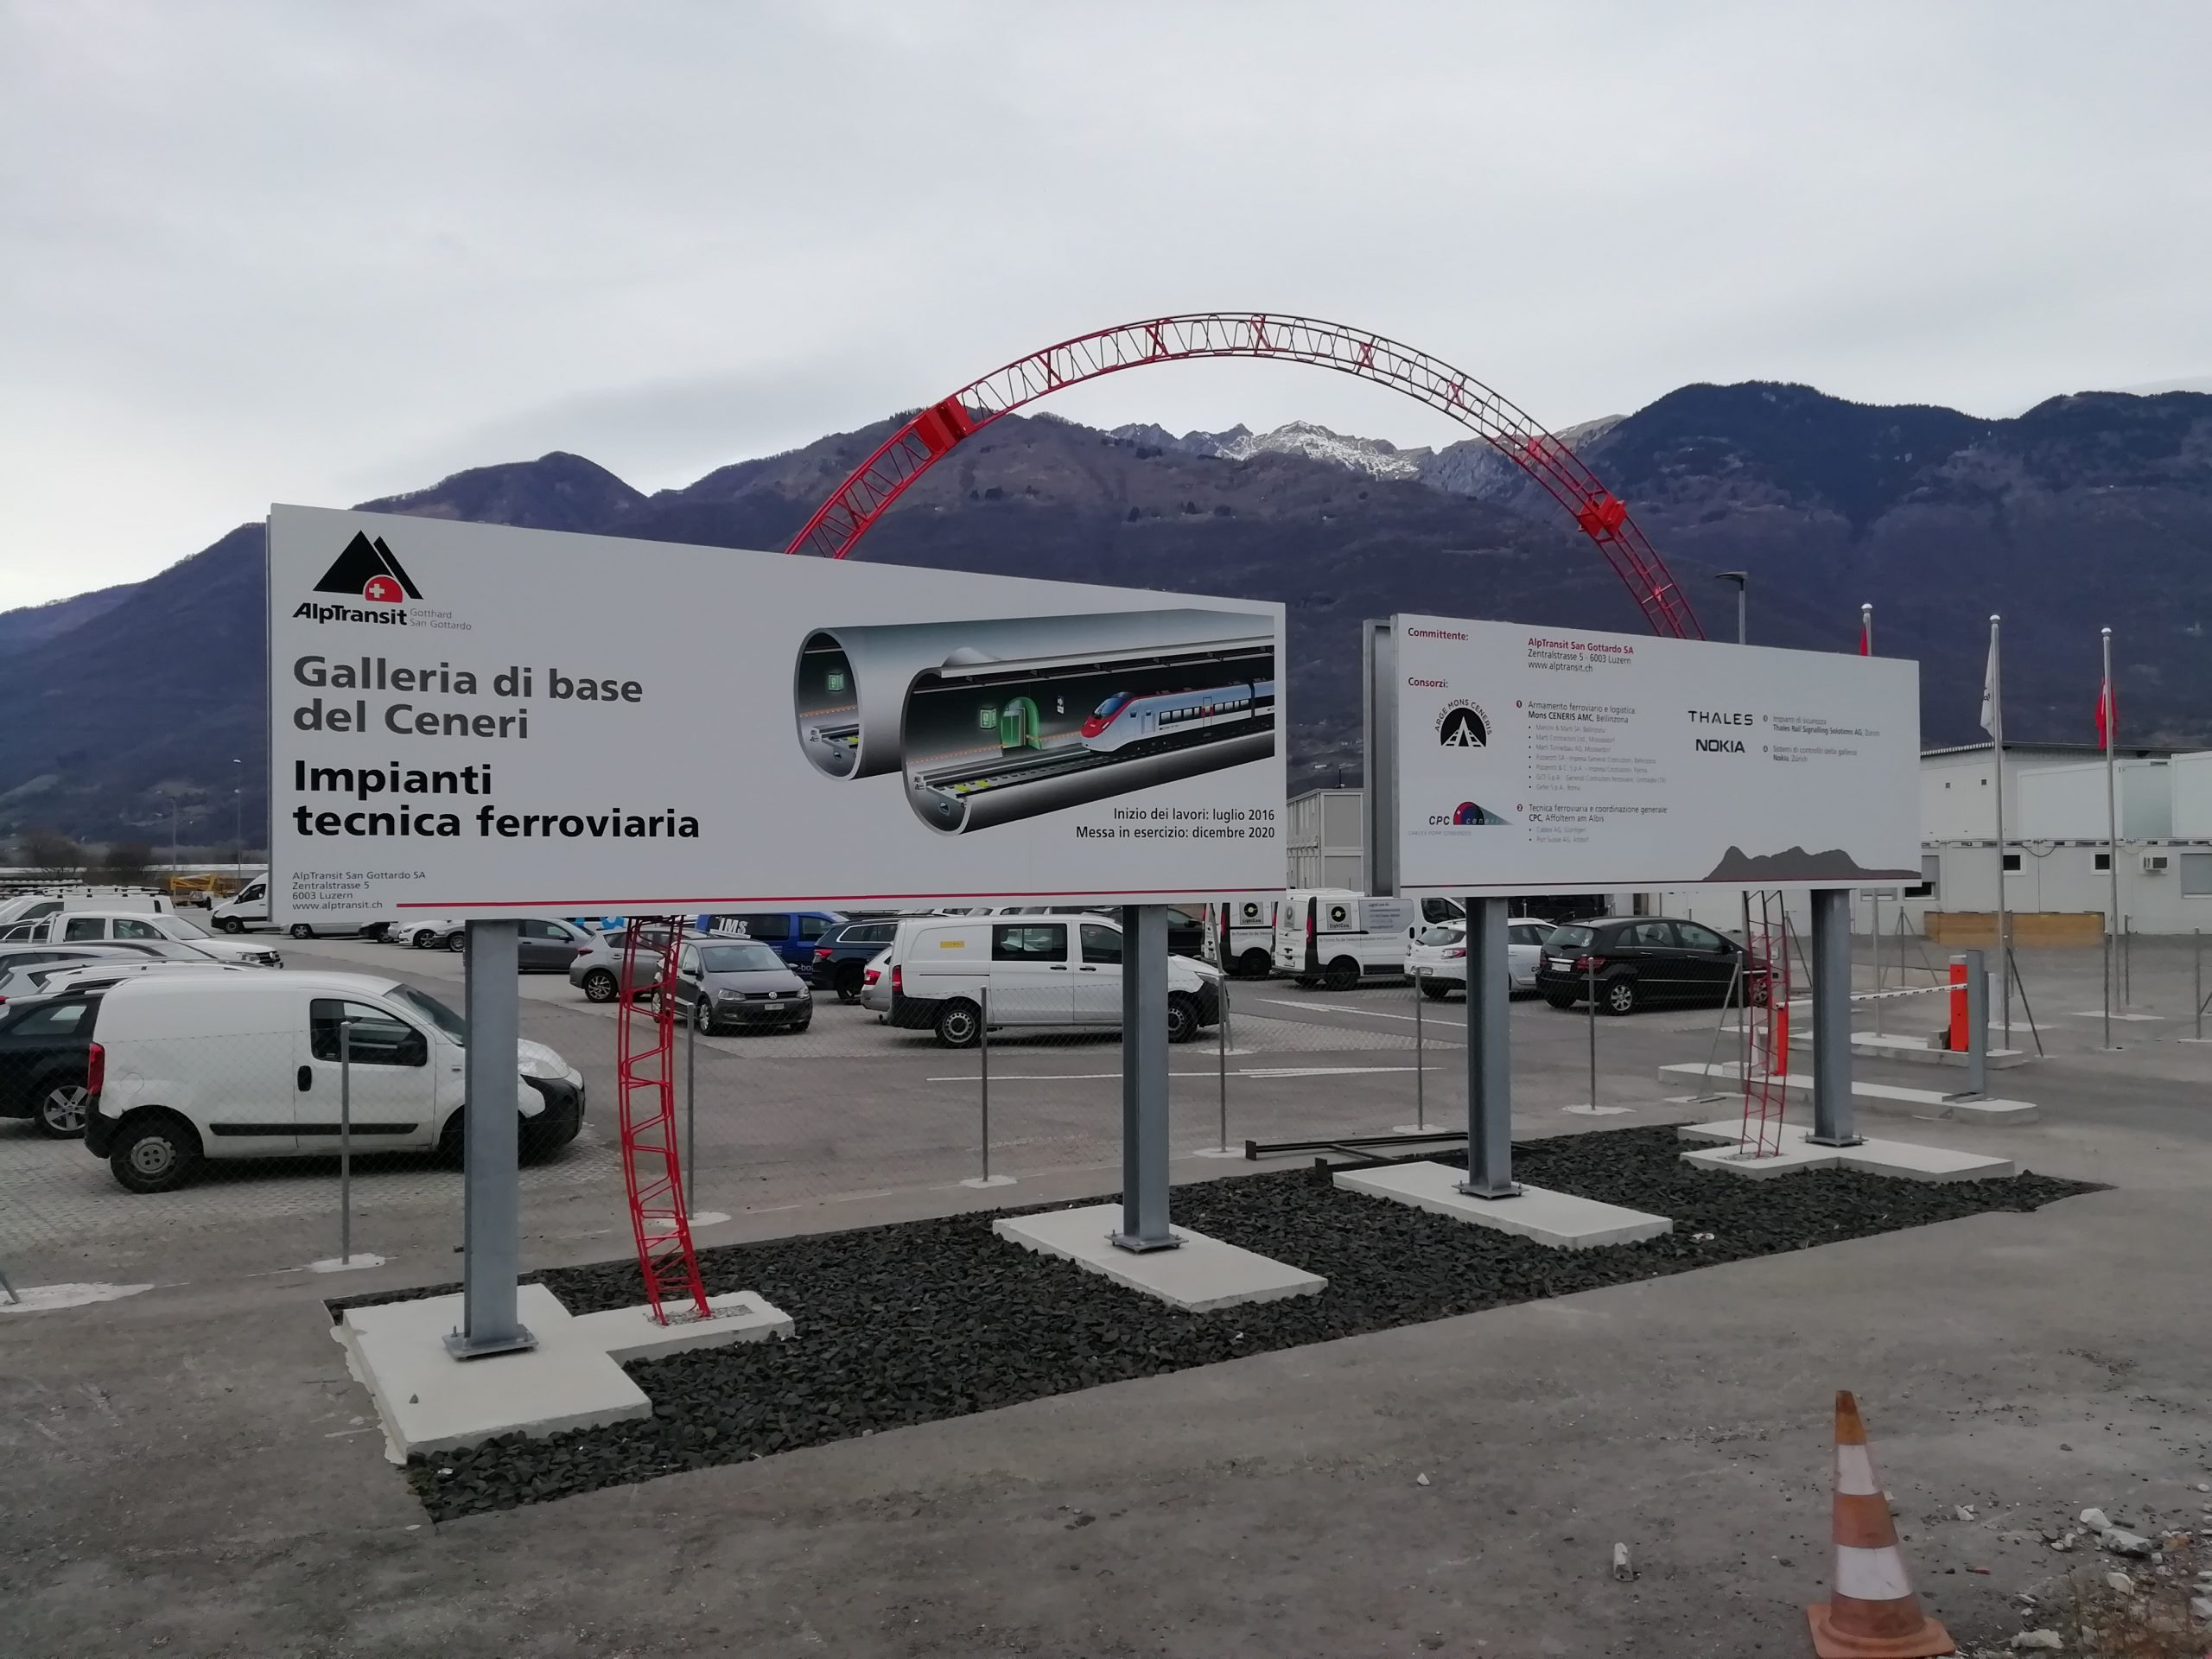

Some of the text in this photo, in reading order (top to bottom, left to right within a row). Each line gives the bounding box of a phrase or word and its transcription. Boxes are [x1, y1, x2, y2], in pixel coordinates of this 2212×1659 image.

[292, 602, 407, 626] AlpTransit
[410, 608, 452, 619] Gotthard
[410, 619, 472, 630] San Gottardo
[1408, 628, 1468, 640] Committente:
[1529, 638, 1568, 649] AlpTransit
[1571, 641, 1585, 651] San
[1588, 643, 1621, 653] Gottardo
[1528, 649, 1577, 660] Zentralstrasse
[1590, 654, 1606, 663] 6003
[1608, 656, 1631, 664] Luzern
[1529, 662, 1592, 672] www.alptransit.ch
[294, 655, 643, 702] Galleria di base
[1408, 677, 1448, 688] Consorzi:
[1529, 701, 1567, 710] Armamento
[294, 698, 527, 739] del Ceneri
[1434, 708, 1447, 732] ARGE
[1448, 699, 1469, 709] MONS
[1548, 712, 1575, 721] CENERIS
[1688, 710, 1753, 726] THALES
[1696, 739, 1745, 753] NOKIA
[296, 760, 492, 800] Impianti
[293, 805, 699, 838] tecnica ferroviaria
[1114, 808, 1274, 823] Inizio dei lavori: luglio 2016
[1429, 817, 1450, 825] CPC
[1077, 826, 1274, 838] Messa in esercizio: dicembre 2020
[292, 872, 342, 881] AlpTransit
[292, 901, 382, 911] www.alptransit.ch
[719, 918, 747, 933] IMS
